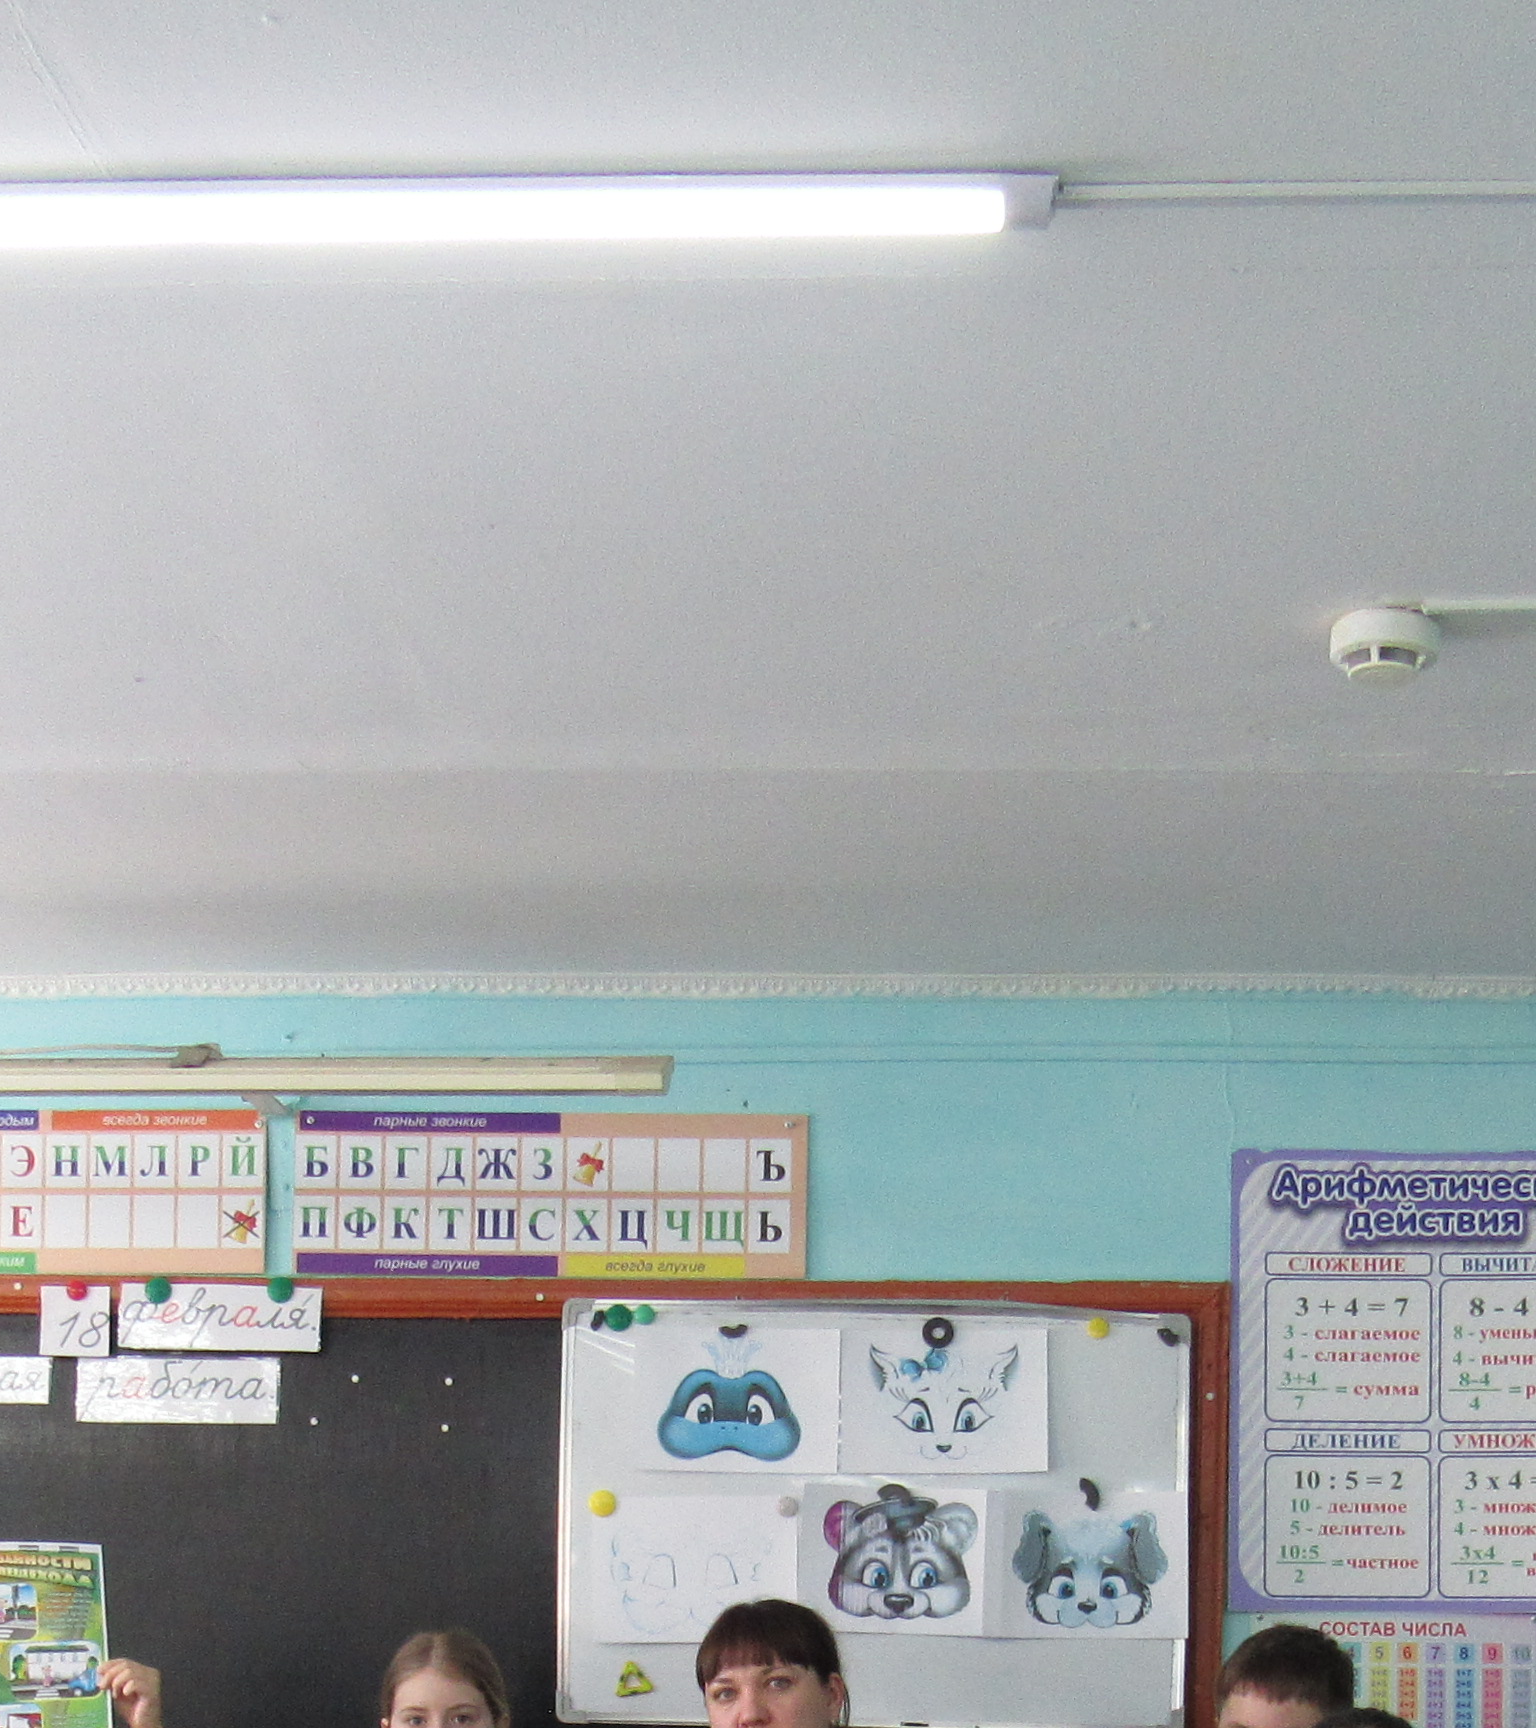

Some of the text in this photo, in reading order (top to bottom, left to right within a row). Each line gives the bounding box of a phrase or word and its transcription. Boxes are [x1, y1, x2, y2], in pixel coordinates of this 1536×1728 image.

[103, 1113, 207, 1126] всегда звонкие
[374, 1115, 486, 1130] парные звонкие
[10, 1146, 36, 1177] Э
[53, 1137, 258, 1177] Н М Л Р Й
[305, 1146, 785, 1186] Б В Г Д Ж З Ъ
[11, 1206, 34, 1237] Е
[299, 1206, 782, 1249] П Ф К Т Ш С Х Ц Ч Щ Ь
[1347, 1204, 1522, 1237] действия
[375, 1258, 480, 1273] парные глухие
[605, 1261, 706, 1275] всегда глухие
[1289, 1257, 1406, 1272] СЛОЖЕНИЕ
[1295, 1297, 1309, 1316] 3
[1345, 1298, 1358, 1316] 4
[1394, 1298, 1408, 1317] 7
[1469, 1297, 1484, 1316] 8
[1513, 1297, 1528, 1316] 4
[59, 1312, 108, 1349] 18
[1283, 1325, 1293, 1339] 3
[1315, 1329, 1420, 1340] слагаемое
[1453, 1326, 1462, 1339] 8
[1283, 1348, 1293, 1361] 4
[1315, 1352, 1420, 1362] слагаемое
[1453, 1351, 1462, 1365] 4
[1281, 1371, 1317, 1386] 3+4
[1354, 1385, 1419, 1399] сумма
[1459, 1372, 1490, 1386] 8-4
[1295, 1395, 1304, 1409] 7
[1470, 1397, 1480, 1410] 4
[1292, 1434, 1400, 1450] ДЕЛЕНИЕ
[1296, 1471, 1320, 1489] 10
[1345, 1471, 1358, 1489] 5
[1391, 1471, 1403, 1489] 2
[1465, 1471, 1477, 1490] 3
[1509, 1471, 1522, 1489] 4
[1291, 1499, 1309, 1513] 10
[1328, 1503, 1407, 1513] делимое
[1454, 1499, 1464, 1513] 3
[1290, 1521, 1300, 1534] 5
[1318, 1525, 1405, 1536] делитель
[1454, 1522, 1463, 1535] 4
[1280, 1545, 1319, 1559] 10:5
[1347, 1559, 1419, 1569] частное
[1461, 1546, 1496, 1560] 3x4
[1294, 1570, 1304, 1583] 2
[1468, 1570, 1488, 1584] 12
[1320, 1622, 1467, 1637] СОСТАВ ЧИСЛА
[1375, 1646, 1384, 1660] 5
[1403, 1646, 1412, 1659] 6
[1431, 1646, 1441, 1660] 7
[1459, 1647, 1468, 1660] 8
[1488, 1648, 1497, 1660] 9
